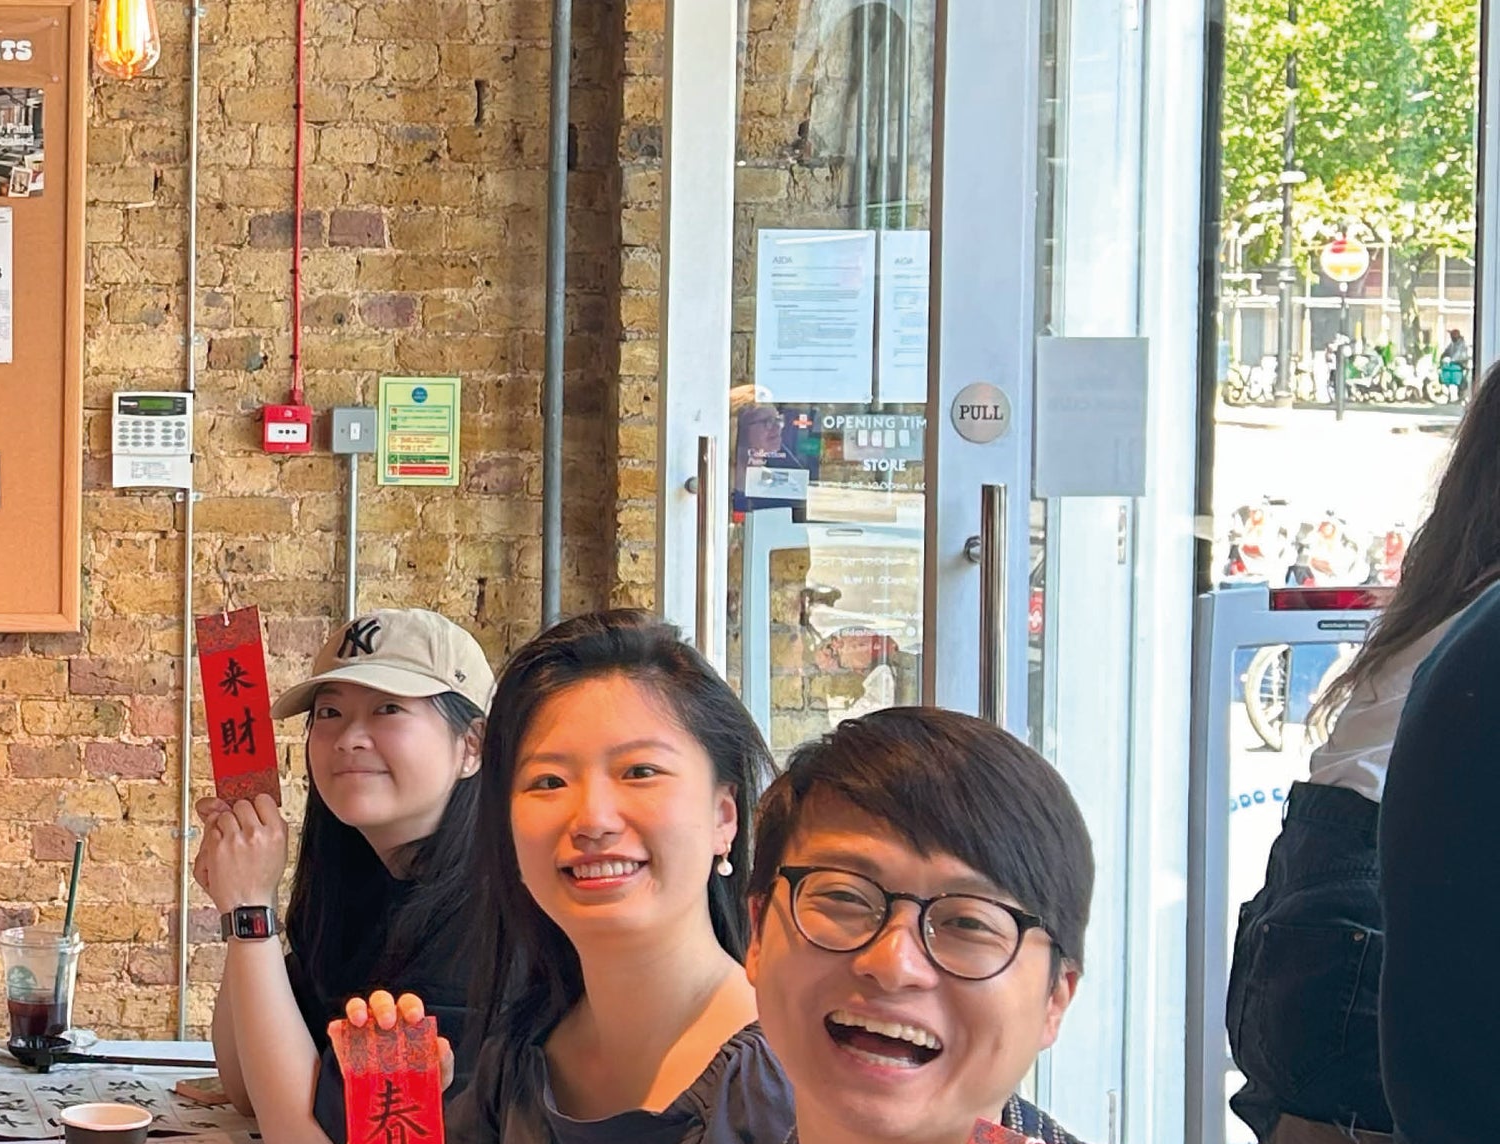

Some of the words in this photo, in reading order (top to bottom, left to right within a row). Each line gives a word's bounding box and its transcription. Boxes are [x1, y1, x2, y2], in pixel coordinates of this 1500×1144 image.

[959, 404, 1003, 421] PULL
[823, 416, 895, 429] OPENING
[863, 458, 906, 472] STORE
